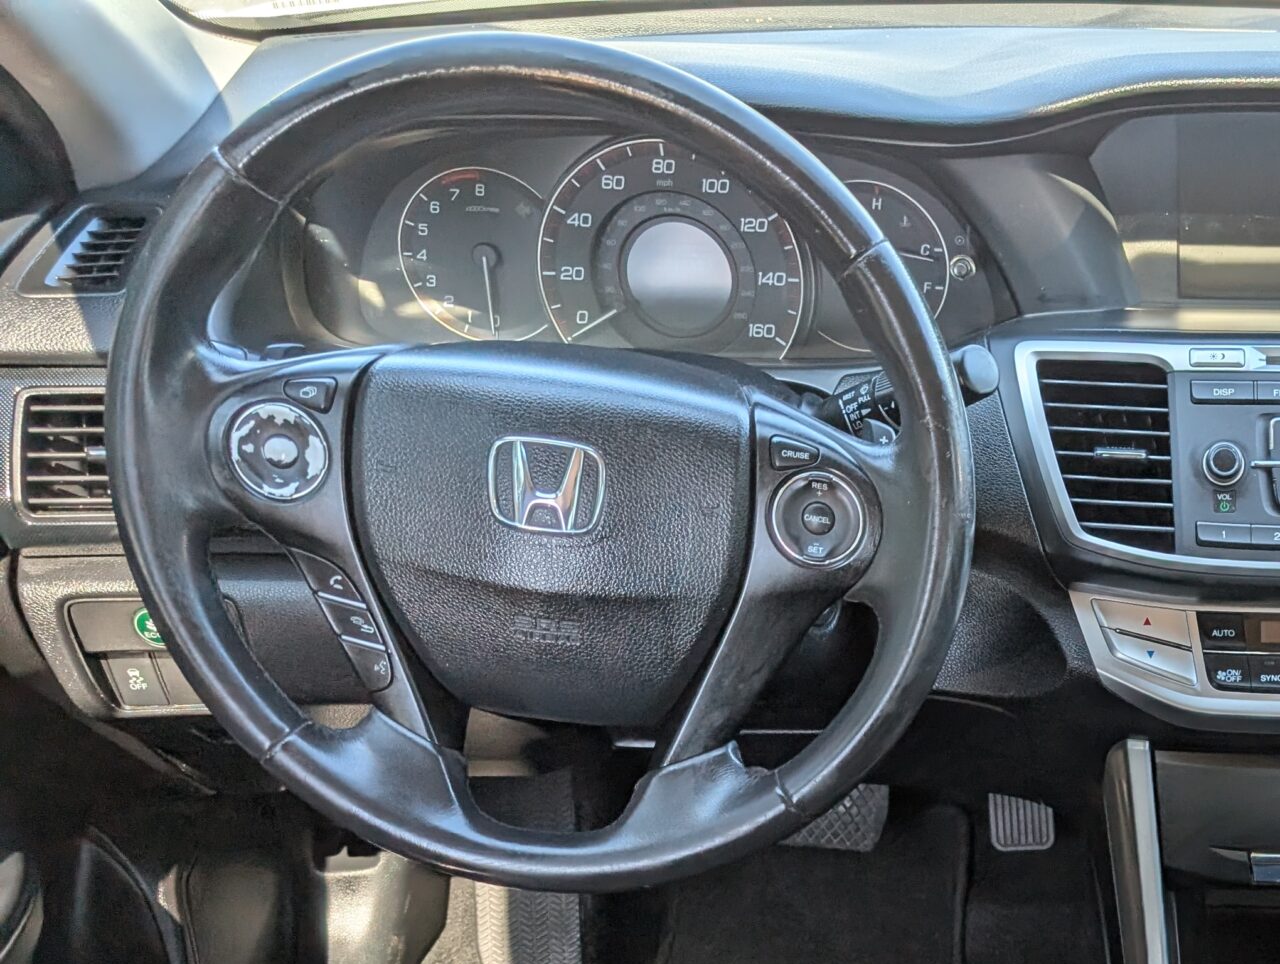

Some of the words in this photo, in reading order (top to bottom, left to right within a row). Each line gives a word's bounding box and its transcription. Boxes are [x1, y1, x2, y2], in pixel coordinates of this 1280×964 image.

[652, 159, 675, 174] 80
[601, 175, 625, 190] 60
[656, 179, 673, 187] mph
[702, 178, 729, 194] 100
[450, 189, 460, 200] 7
[475, 184, 485, 197] 8
[430, 201, 440, 213] 6
[872, 198, 882, 210] H
[567, 213, 592, 227] 40
[740, 218, 768, 233] 120
[418, 223, 428, 235] 5
[416, 249, 427, 261] 4
[920, 244, 930, 256] C
[560, 267, 584, 280] 20
[757, 271, 786, 286] 140
[426, 275, 436, 287] 3
[923, 282, 932, 294] F
[443, 296, 454, 308] 2
[467, 310, 472, 323] 1
[576, 310, 588, 324] 0
[749, 324, 775, 338] 160
[1213, 388, 1235, 396] DISP
[858, 394, 872, 404] PULL
[845, 401, 858, 414] OFF
[849, 410, 861, 420] INT
[781, 449, 810, 460] CRUISE
[811, 481, 828, 490] RES
[1216, 493, 1233, 501] VOL
[804, 513, 831, 524] CANCEL
[1273, 532, 1280, 541] 2
[807, 545, 824, 554] SET
[1211, 629, 1236, 638] AUTO
[1225, 675, 1242, 683] OFF
[1226, 669, 1242, 677] ON/
[129, 683, 148, 691] OFF
